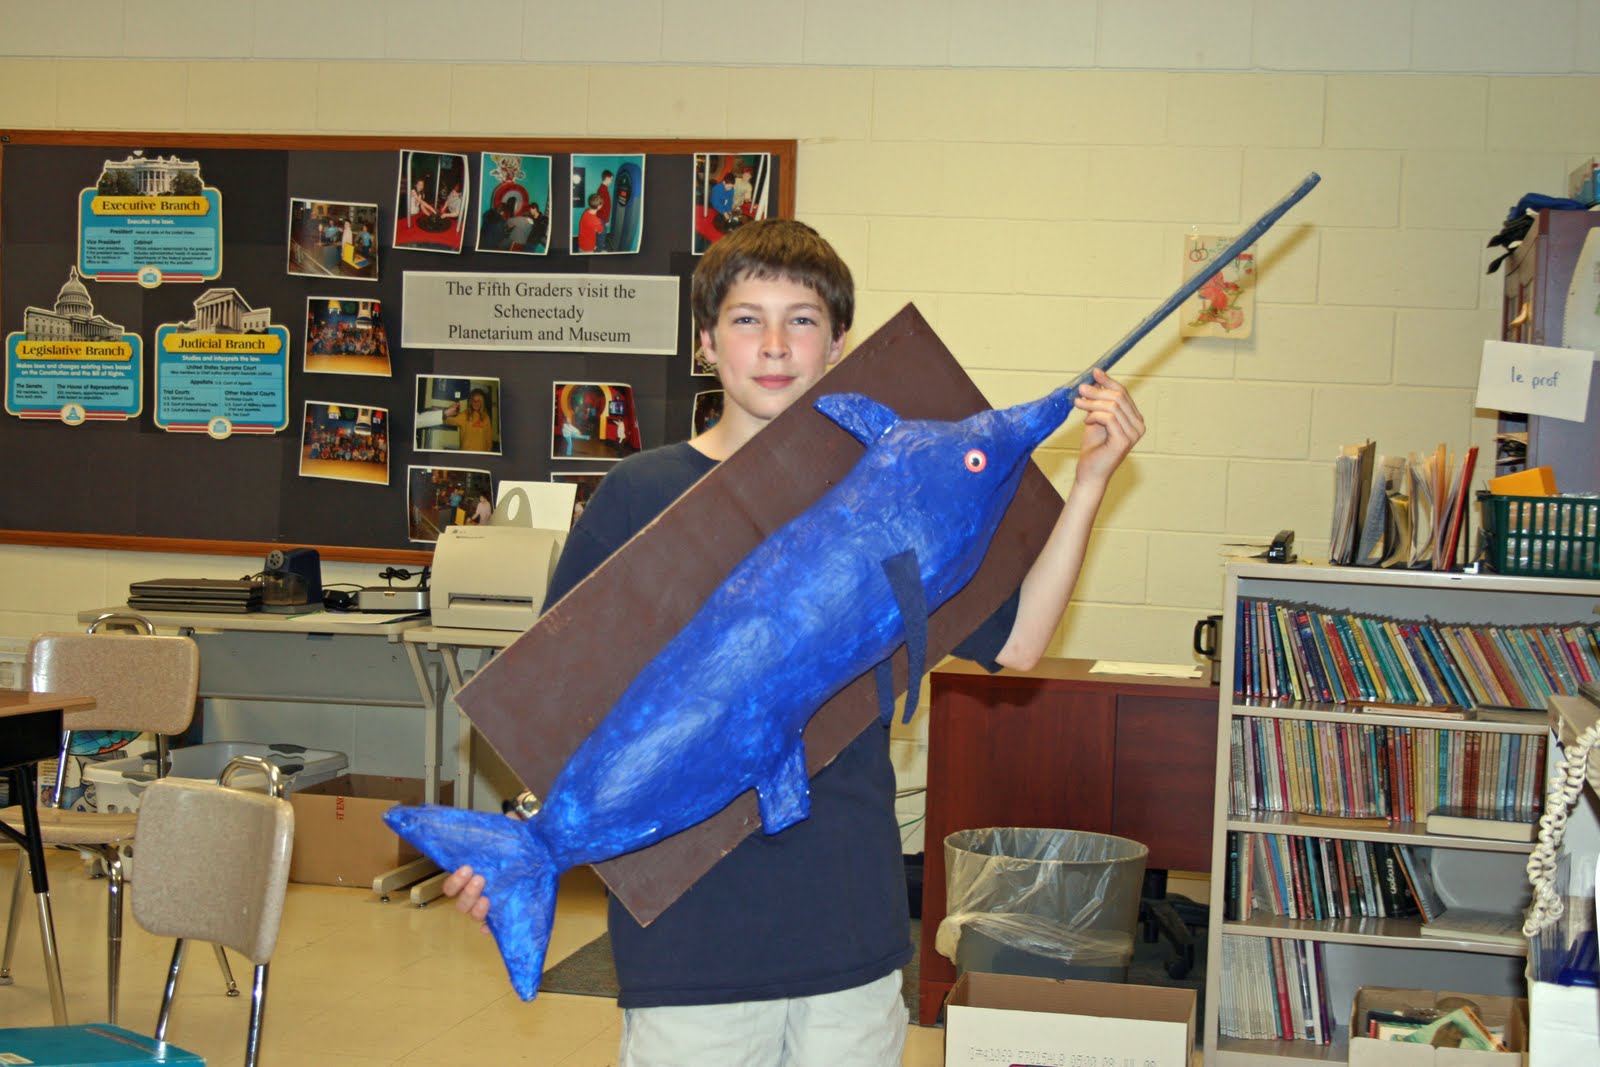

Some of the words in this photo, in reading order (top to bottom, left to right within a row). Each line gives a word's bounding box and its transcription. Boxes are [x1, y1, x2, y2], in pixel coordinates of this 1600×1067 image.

[102, 200, 156, 211] Executive
[160, 200, 200, 211] Branch
[446, 281, 472, 296] The
[478, 282, 510, 296] Fifth
[516, 282, 573, 297] Graders
[578, 284, 608, 298] visit
[614, 284, 636, 299] the
[494, 304, 584, 322] Schenectady
[448, 325, 533, 341] Planetarium
[538, 326, 564, 341] and
[569, 327, 631, 342] Museum
[23, 345, 81, 356] Legislative
[86, 346, 124, 356] Branch
[178, 339, 221, 349] Judicial
[226, 340, 265, 349] Branch
[1511, 366, 1524, 383] le
[1532, 371, 1560, 389] prof
[1386, 858, 1397, 894] eragon
